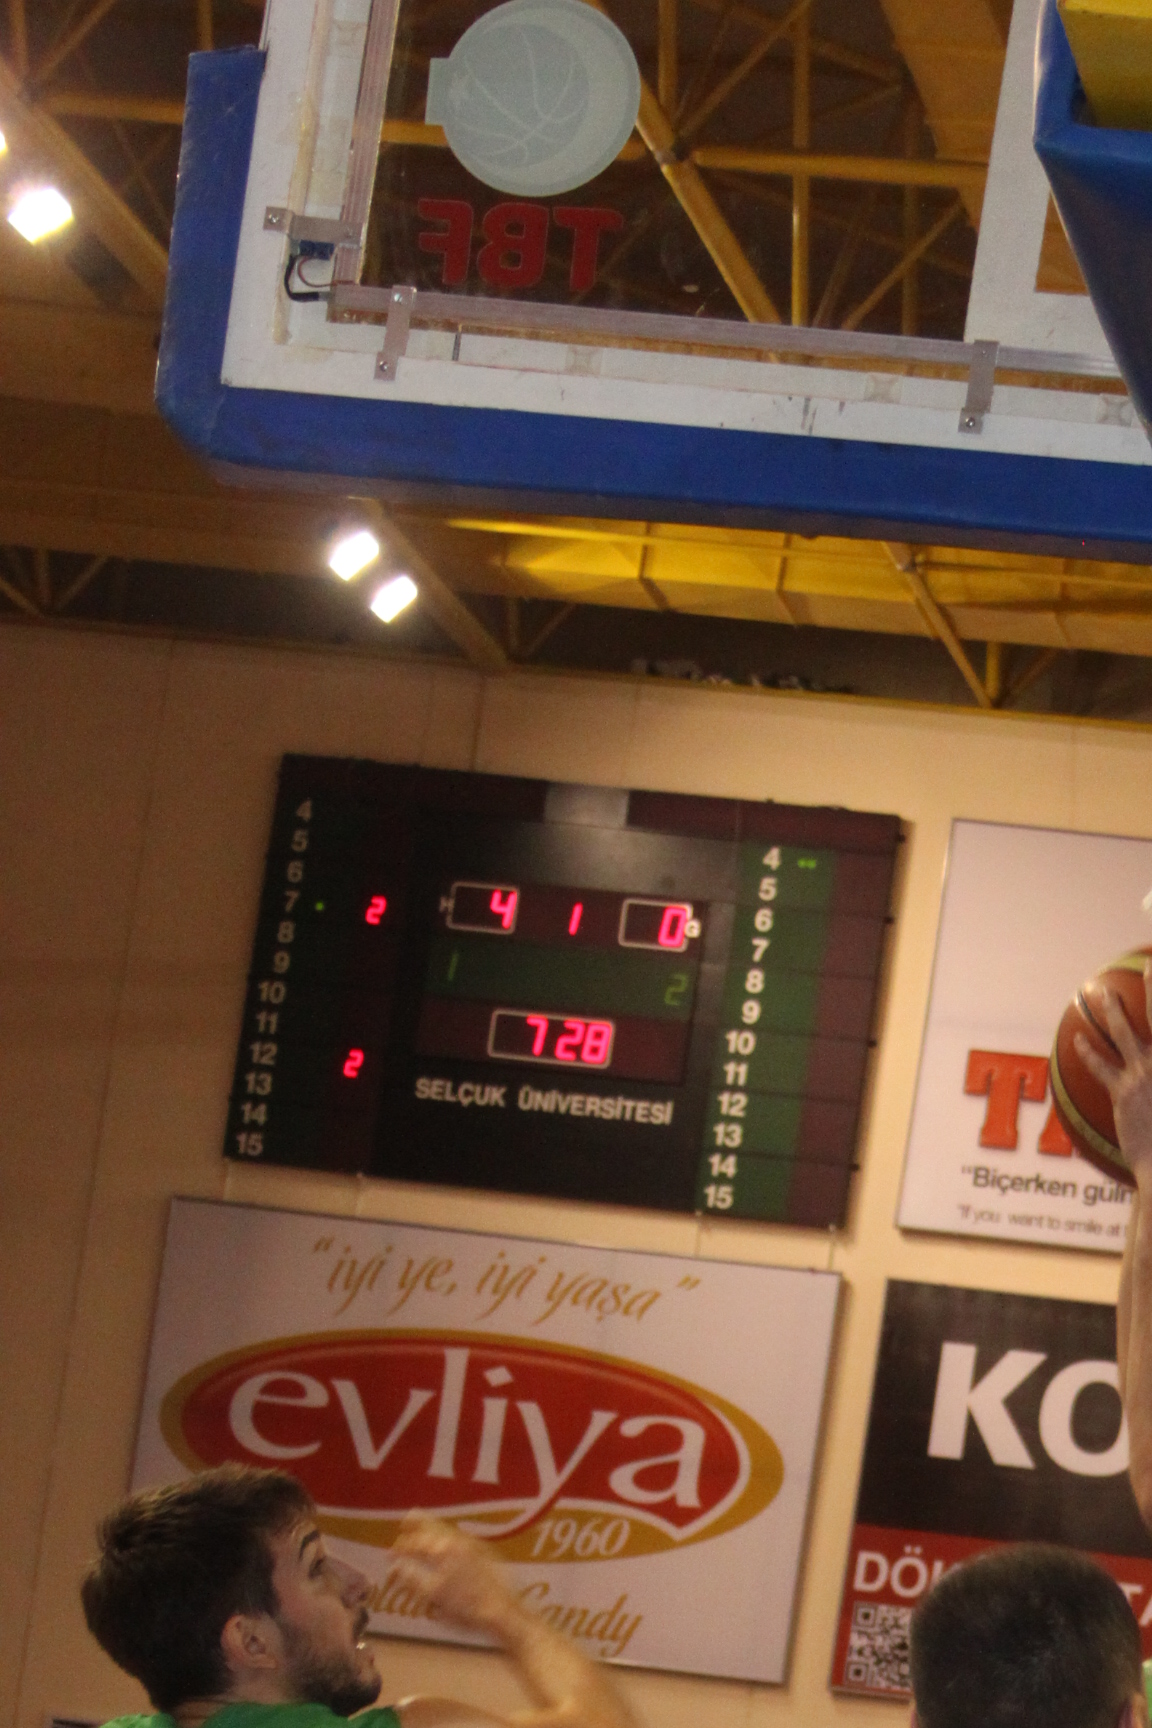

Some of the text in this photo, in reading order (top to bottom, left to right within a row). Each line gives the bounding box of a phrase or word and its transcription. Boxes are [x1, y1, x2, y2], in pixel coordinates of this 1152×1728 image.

[297, 799, 312, 822] 4
[291, 829, 308, 852] 5
[763, 846, 781, 870] 4
[287, 860, 303, 883] 6
[284, 890, 299, 912] 7
[759, 877, 777, 901] 5
[365, 895, 387, 925] 2
[490, 889, 690, 948] 4 1 0
[754, 907, 773, 932] 6
[277, 920, 295, 943] 8
[751, 937, 770, 962] 7
[273, 951, 290, 974] 9
[258, 981, 286, 1004] 10
[745, 968, 764, 993] 8
[256, 1011, 278, 1034] 11
[742, 999, 761, 1024] 9
[251, 1042, 277, 1065] 12
[725, 1030, 756, 1055] 10
[343, 1048, 364, 1078] 2
[723, 1061, 748, 1086] 11
[244, 1072, 272, 1096] 13
[241, 1102, 267, 1125] 14
[415, 1077, 674, 1126] SELÇUK ÜNİVERSİTESİ
[718, 1091, 747, 1117] 12
[235, 1132, 263, 1156] 15
[713, 1122, 742, 1148] 13
[708, 1153, 737, 1178] 14
[704, 1183, 734, 1209] 15
[228, 1347, 706, 1537] evliya
[531, 1517, 631, 1560] 1960
